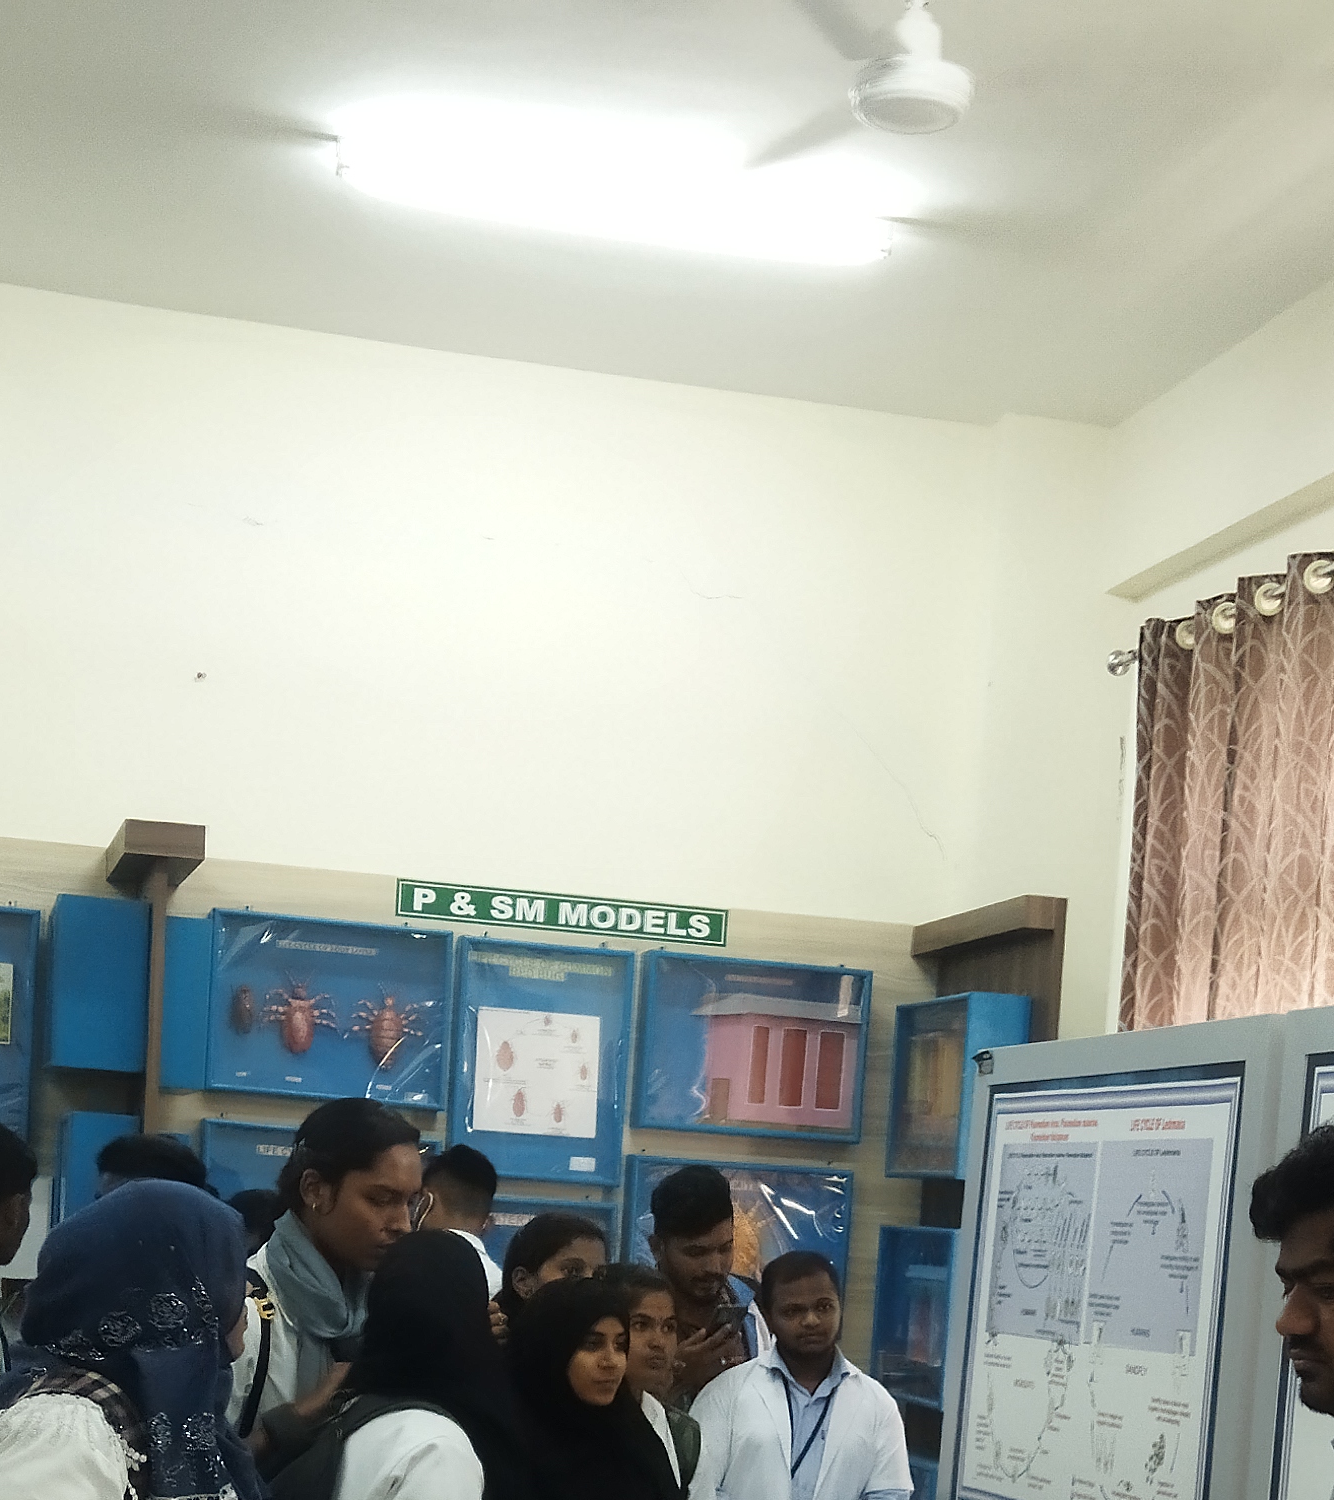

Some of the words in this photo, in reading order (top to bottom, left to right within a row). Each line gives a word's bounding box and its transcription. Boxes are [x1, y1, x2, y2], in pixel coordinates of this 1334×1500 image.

[414, 888, 436, 911] P
[449, 891, 477, 916] &
[490, 896, 546, 923] SM
[558, 901, 710, 938] MODELS
